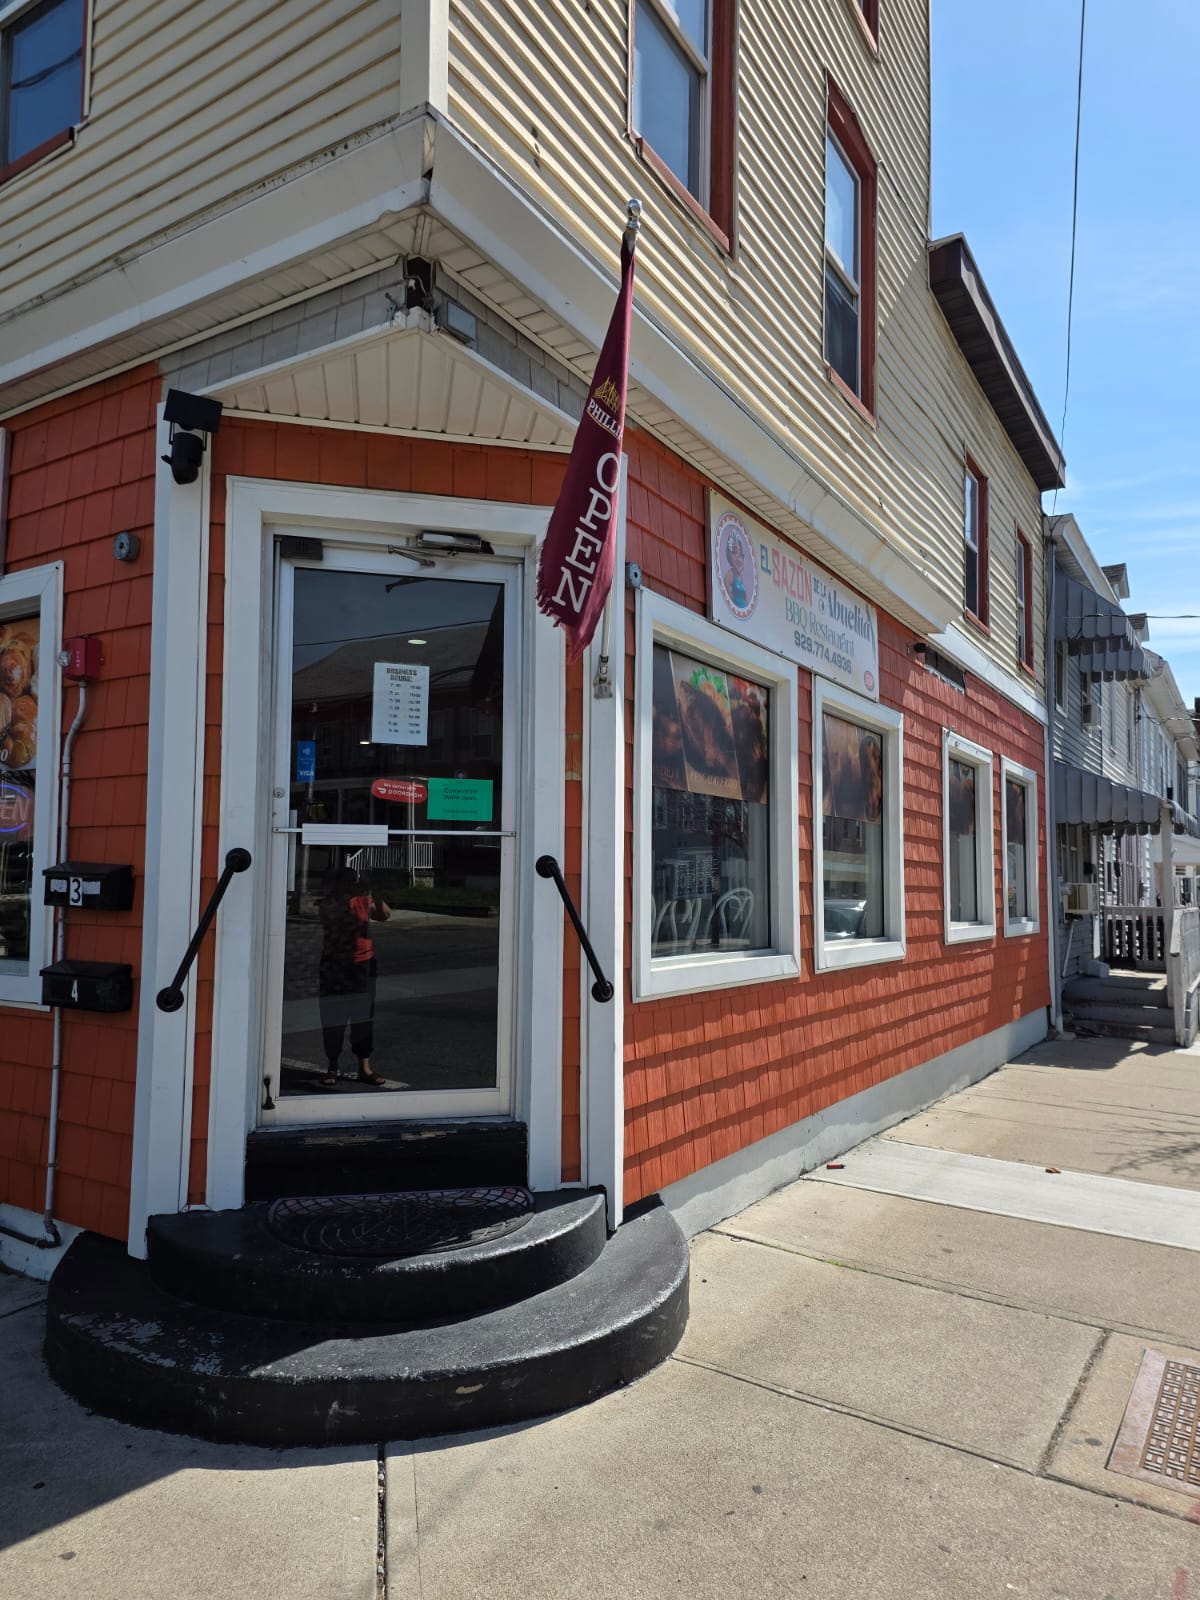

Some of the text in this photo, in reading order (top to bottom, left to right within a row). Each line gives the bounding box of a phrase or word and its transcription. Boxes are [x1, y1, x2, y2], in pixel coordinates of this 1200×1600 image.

[552, 451, 620, 614] OPEN
[760, 543, 772, 576] EL
[785, 597, 808, 634] BBQ
[71, 878, 81, 904] 3
[71, 979, 79, 1003] 4
